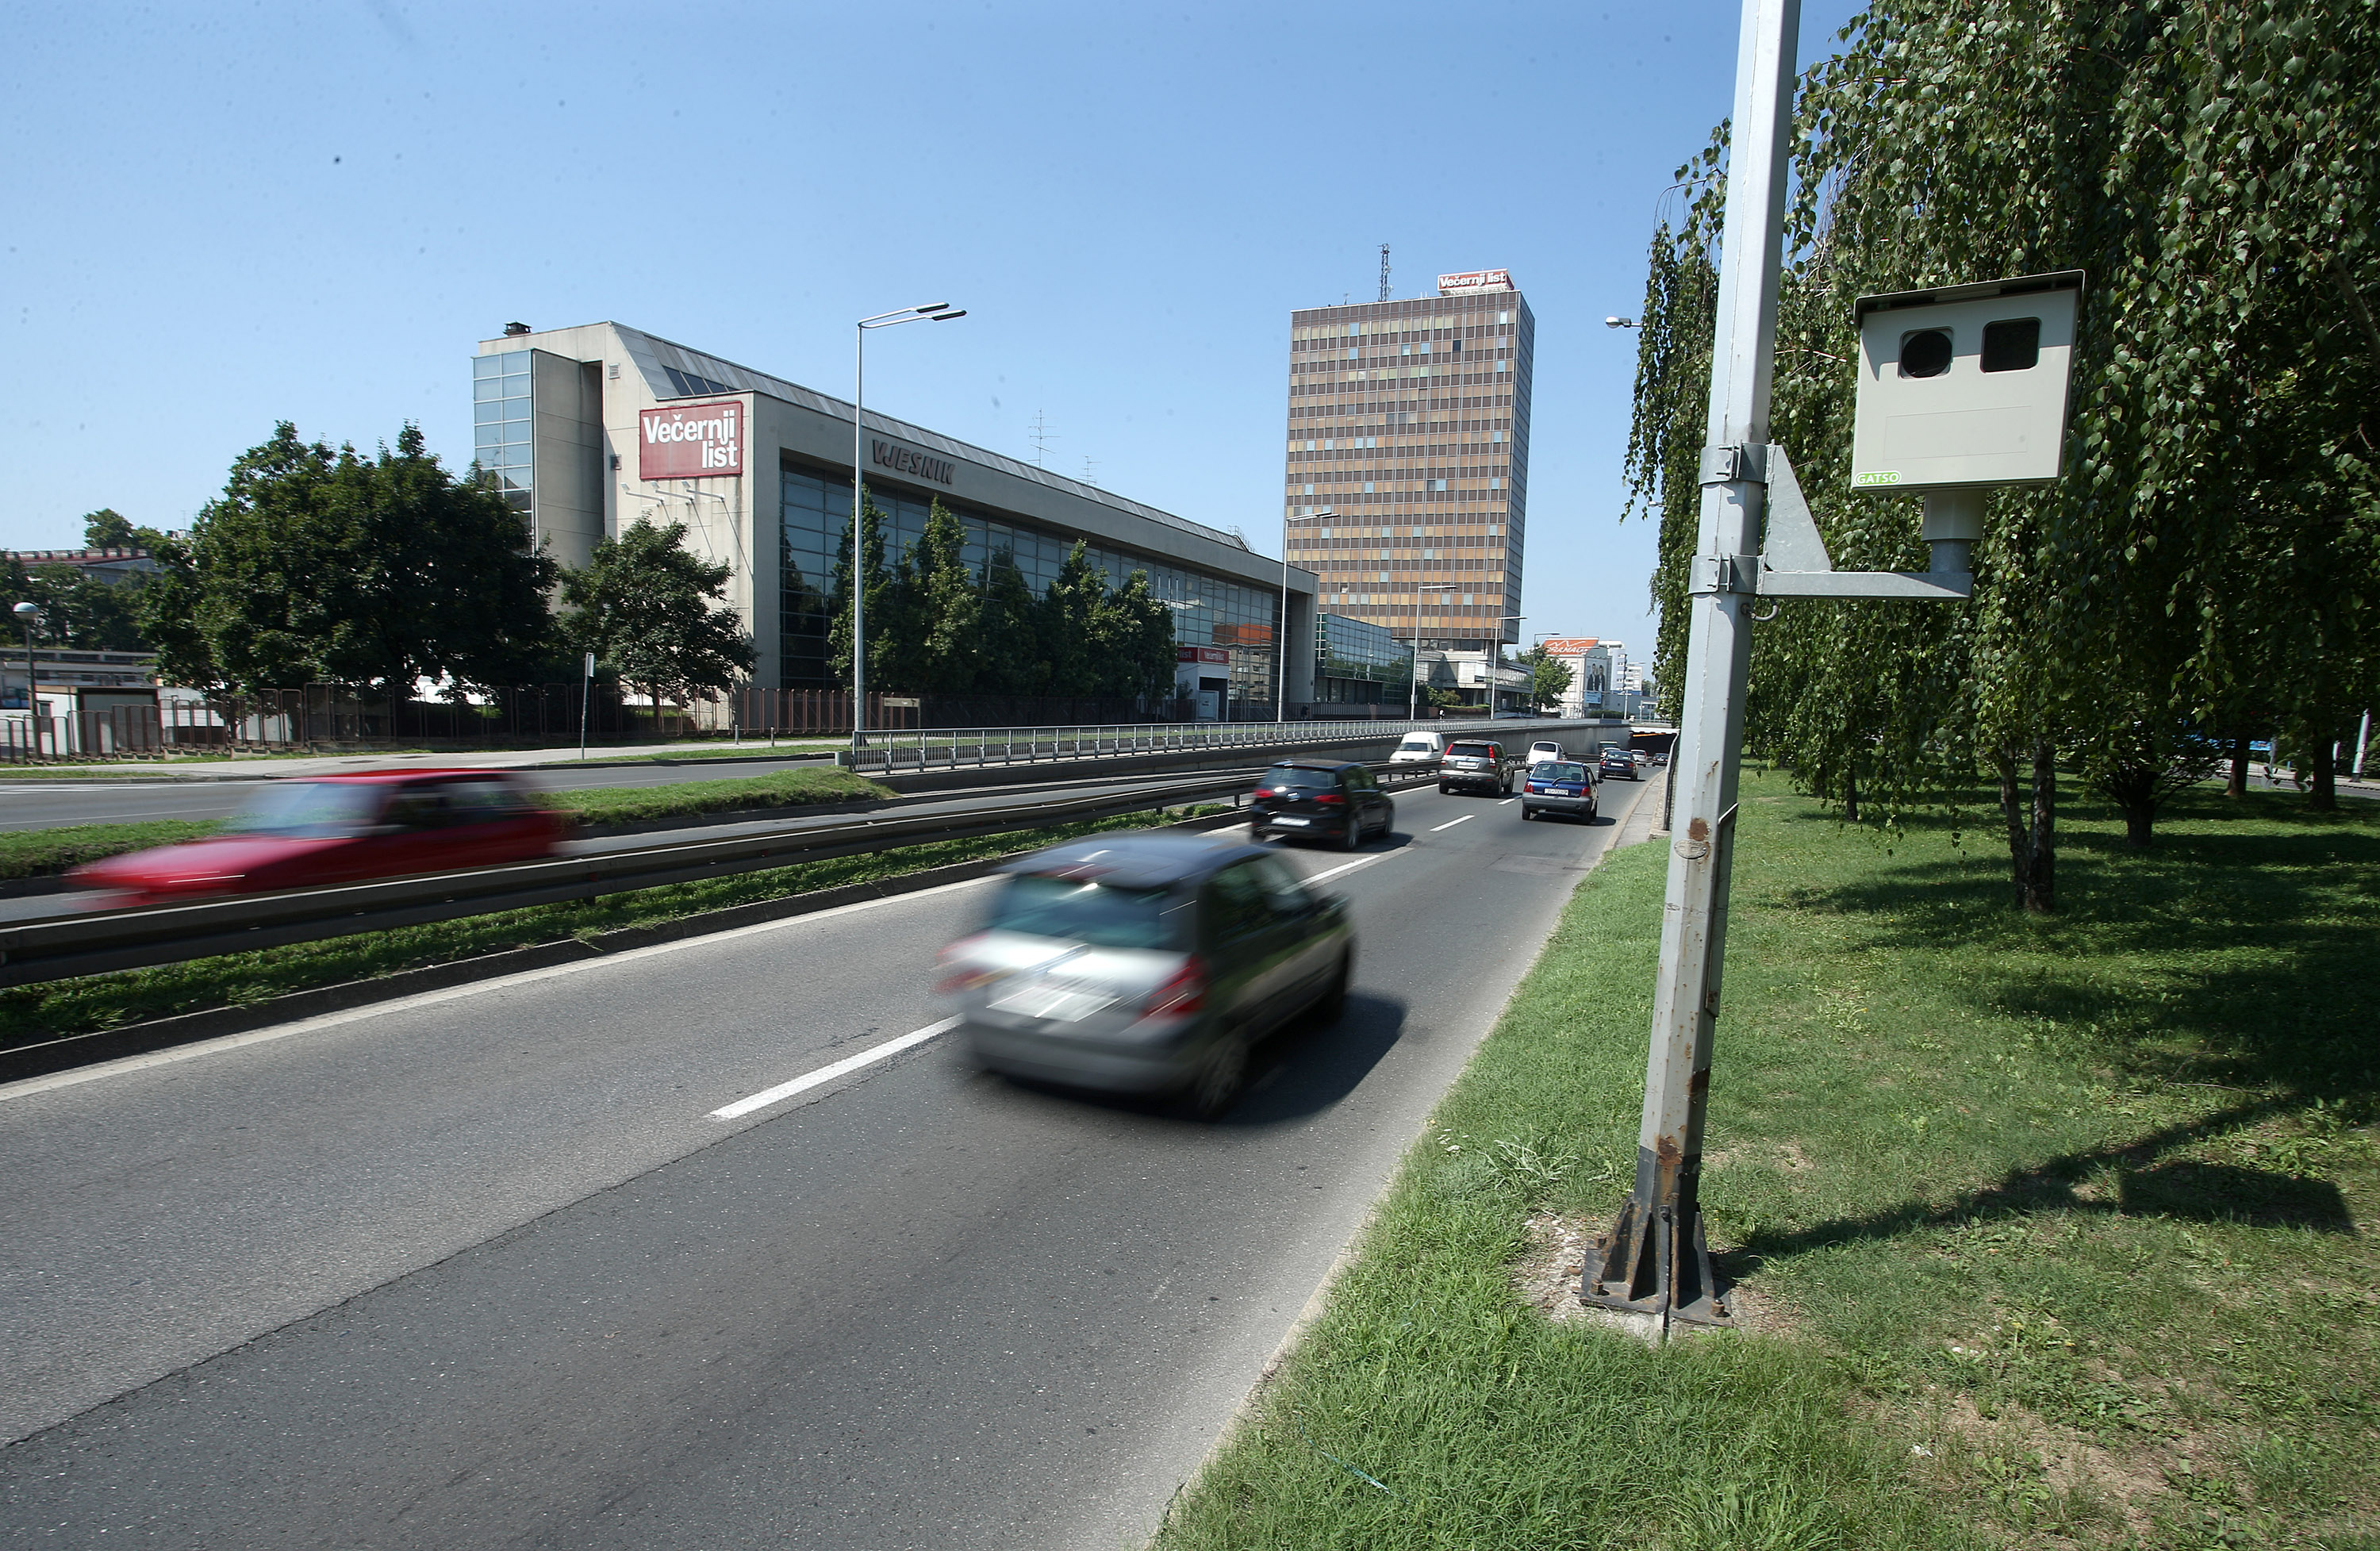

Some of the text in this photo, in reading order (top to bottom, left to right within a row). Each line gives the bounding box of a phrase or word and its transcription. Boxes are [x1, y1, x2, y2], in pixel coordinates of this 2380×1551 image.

[1440, 272, 1506, 287] Večernji list
[643, 409, 735, 445] Večernji
[701, 440, 739, 468] list
[873, 440, 956, 485] VJESNIK
[1856, 473, 1899, 484] GATSO
